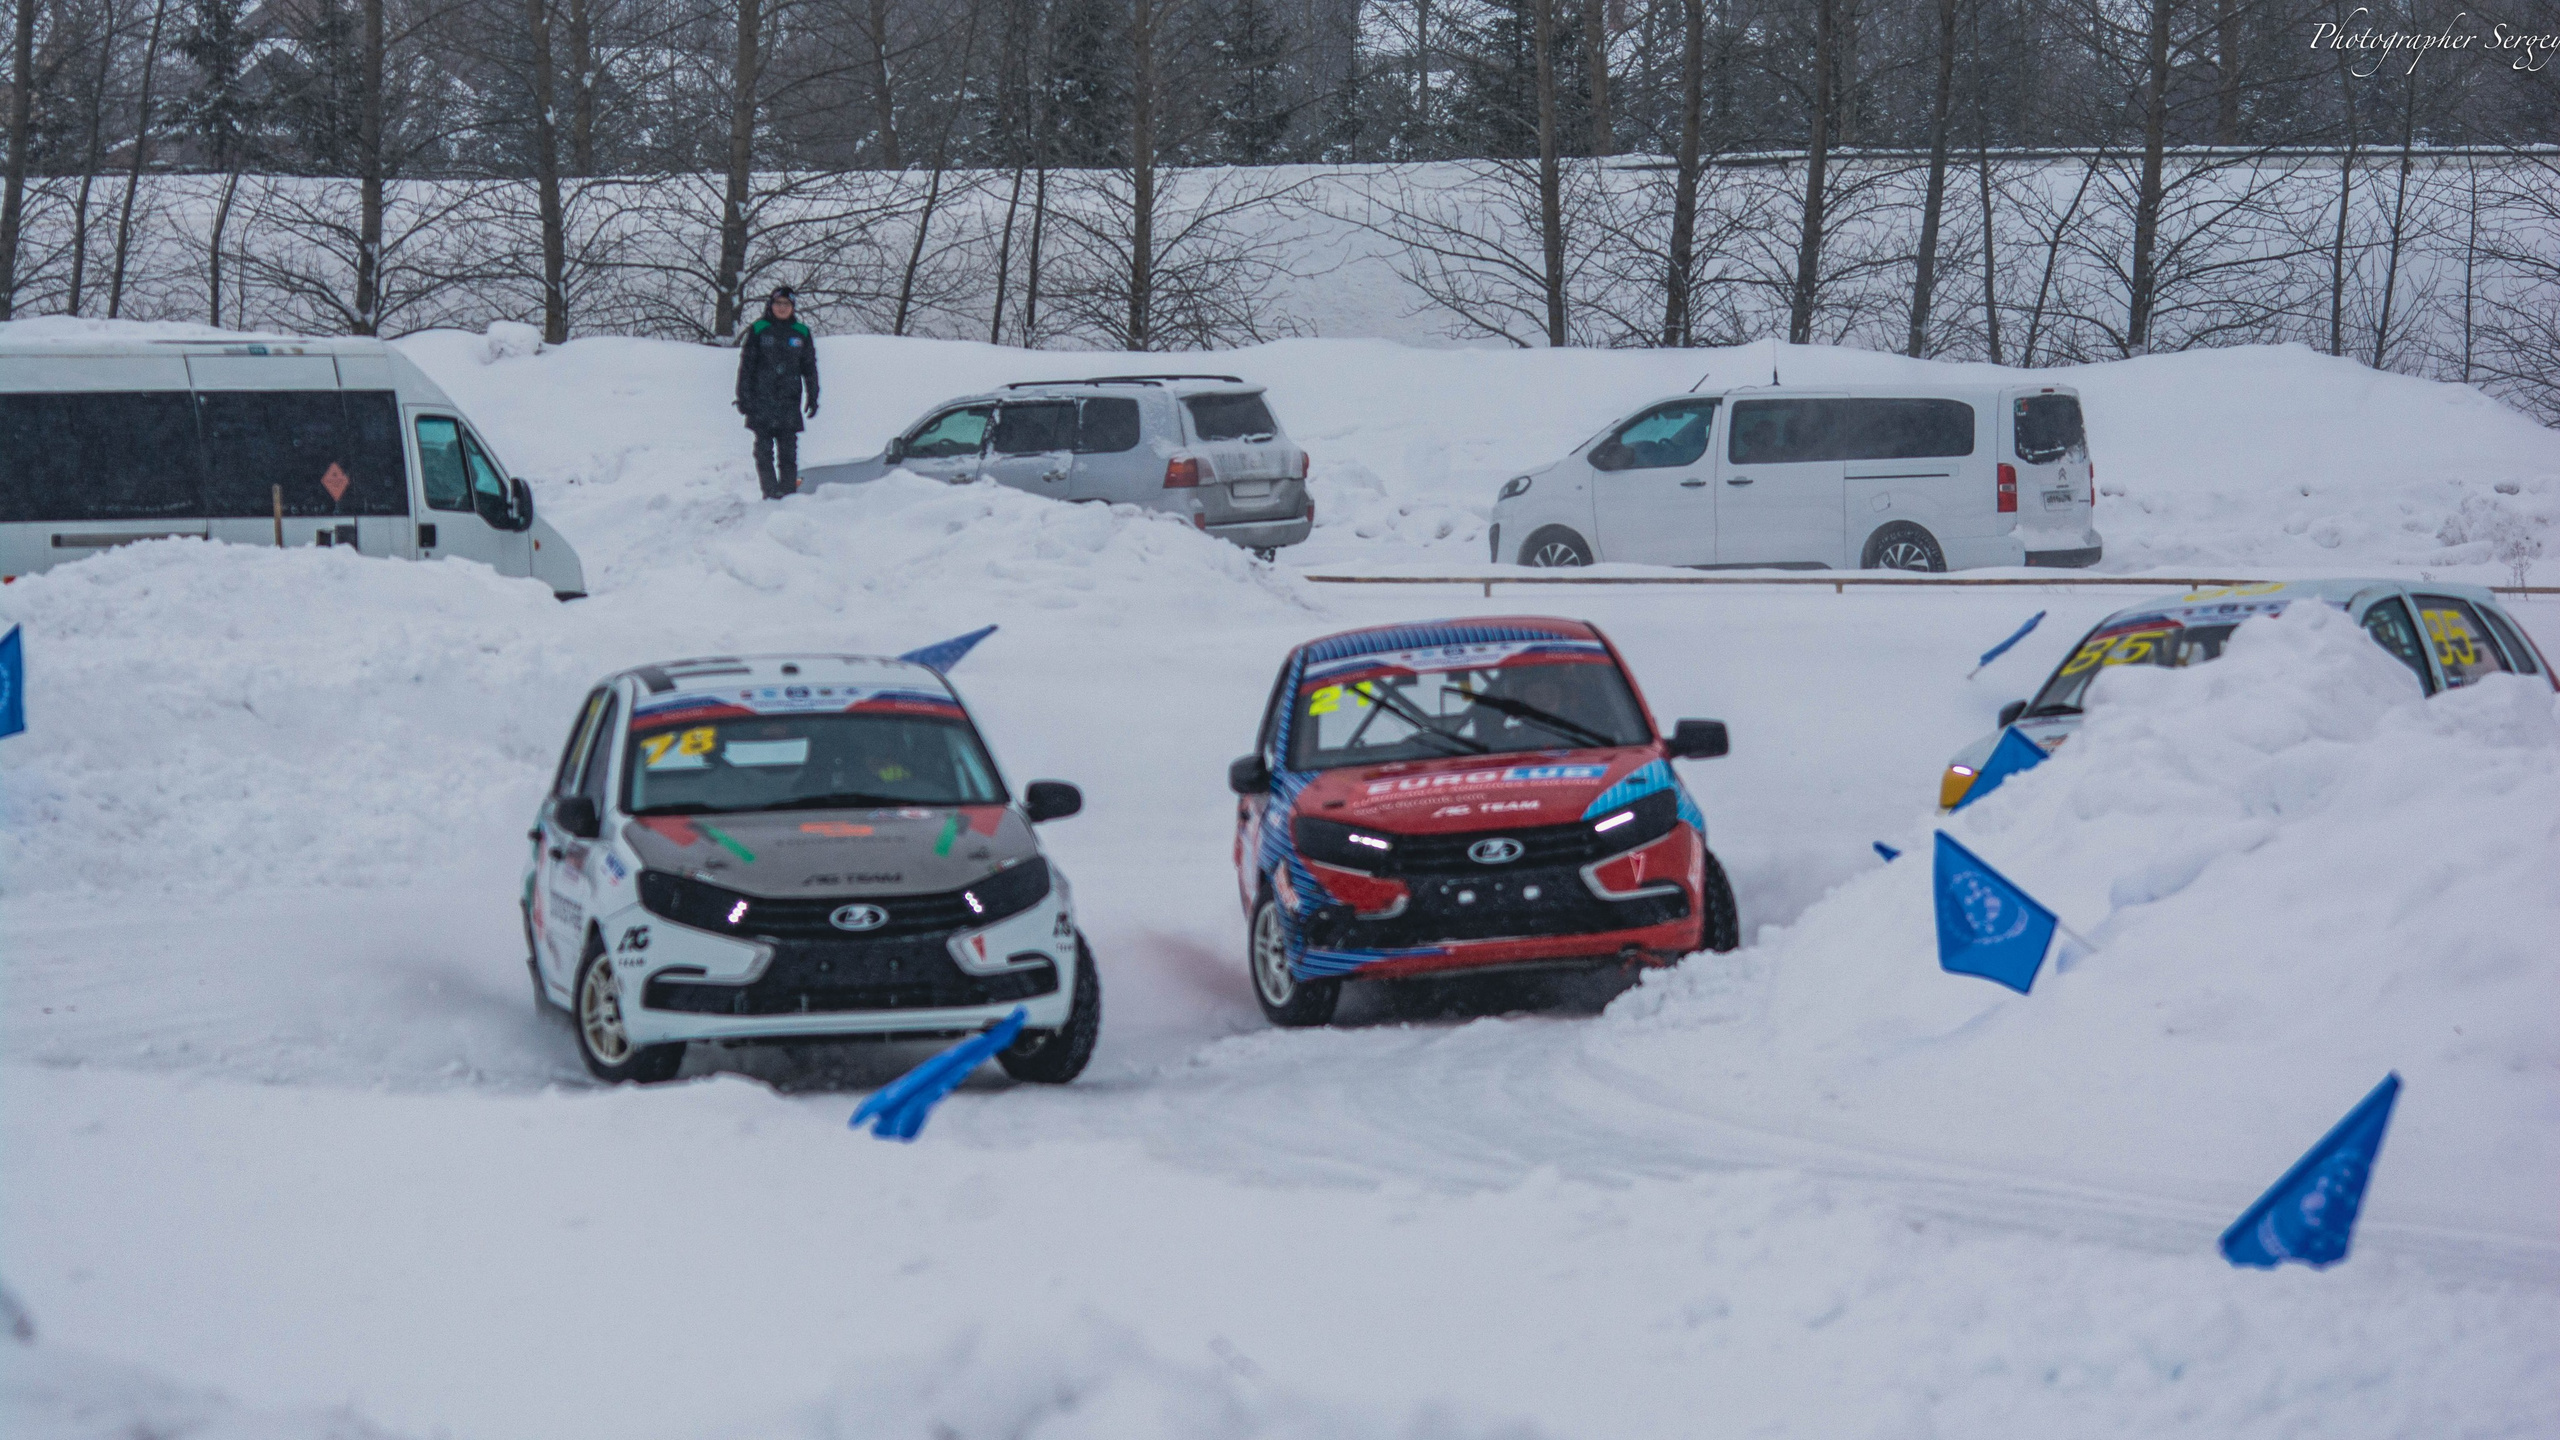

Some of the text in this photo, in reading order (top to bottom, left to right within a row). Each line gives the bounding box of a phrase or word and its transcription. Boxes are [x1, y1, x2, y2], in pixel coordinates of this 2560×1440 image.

[2059, 631, 2168, 678] 85
[2421, 609, 2475, 666] 85
[640, 726, 717, 767] 78
[1366, 765, 1594, 795] EUROLUB
[1479, 800, 1541, 814] TEAM
[847, 871, 904, 885] TEAM
